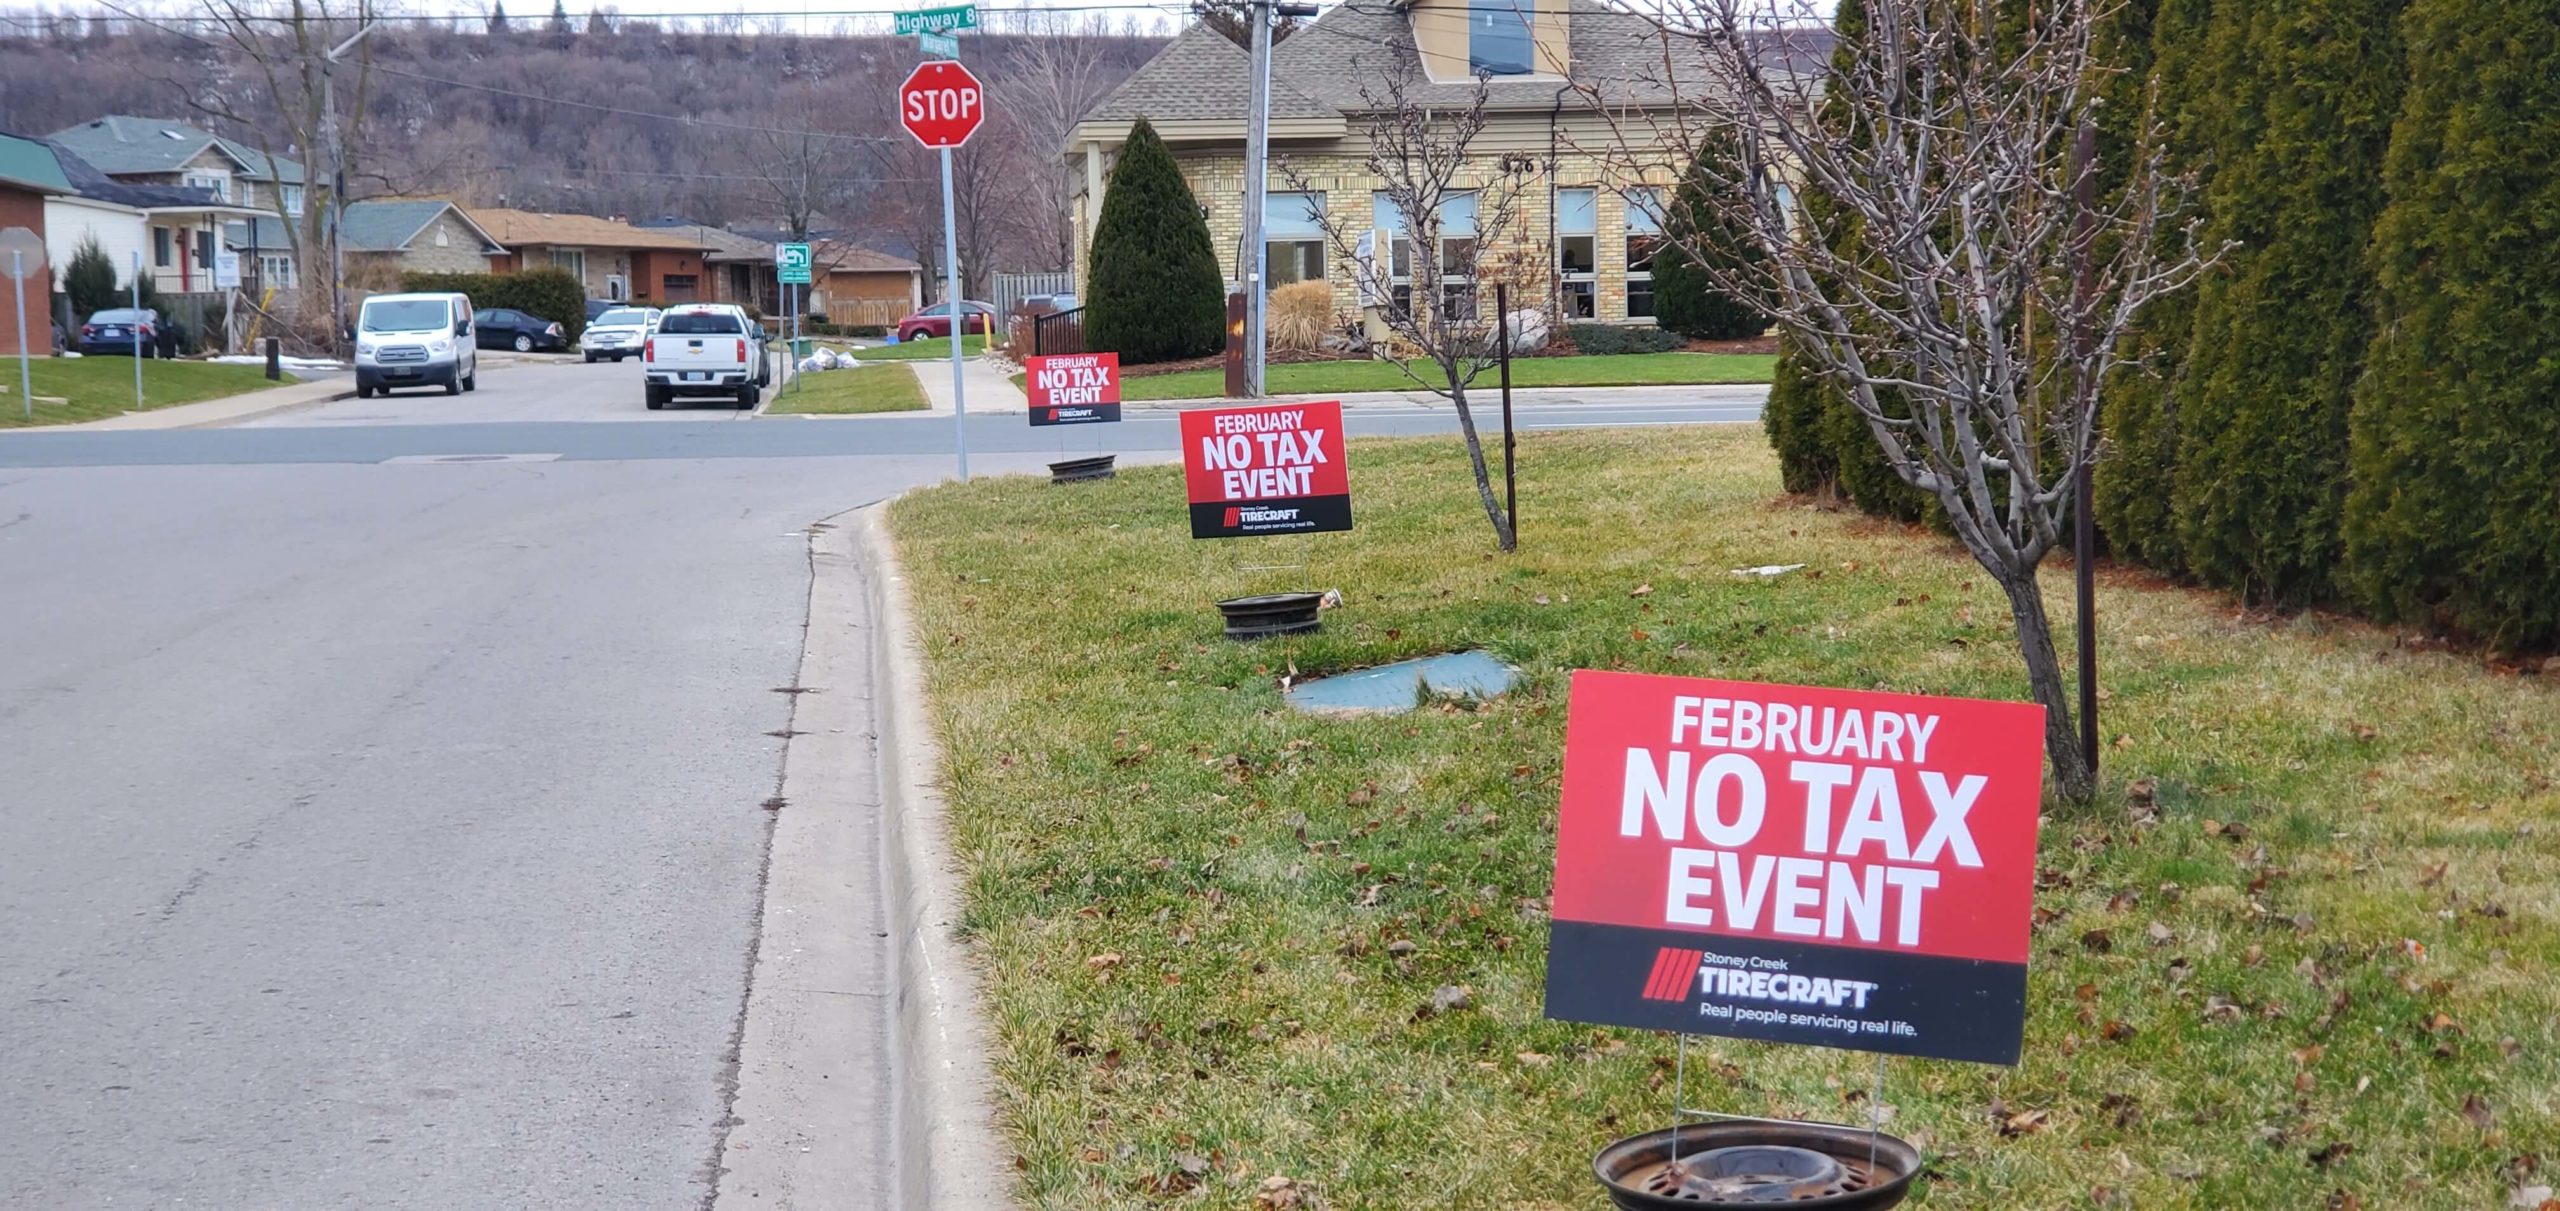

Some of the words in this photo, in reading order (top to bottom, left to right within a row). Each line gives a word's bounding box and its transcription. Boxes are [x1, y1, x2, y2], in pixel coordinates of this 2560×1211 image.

[895, 12, 960, 33] Highway
[965, 8, 976, 23] 8
[907, 87, 978, 122] STOP
[1038, 369, 1068, 389] NO
[1070, 367, 1110, 387] TAX
[1046, 356, 1098, 369] FEBRUARY
[1049, 386, 1103, 405] EVENT
[1214, 410, 1304, 434] FEBRUARY
[1202, 434, 1252, 470] NO
[1256, 429, 1328, 467] TAX
[1223, 465, 1314, 499] EVENT
[1239, 509, 1298, 522] TIRECRAFT
[1671, 695, 1940, 763] FEBRUARY
[1620, 747, 1767, 847] NO
[1790, 760, 1989, 867] TAX
[1666, 847, 1940, 946] EVENT
[1703, 951, 1748, 970] Stoney
[1750, 956, 1789, 971] Creek
[1698, 966, 1873, 1009] TIRECRAFT
[1700, 1002, 1733, 1019] Real
[1735, 1007, 1788, 1026] people
[1790, 1013, 1858, 1034] servicing
[1861, 1019, 1889, 1034] real
[1891, 1020, 1918, 1037] life.
